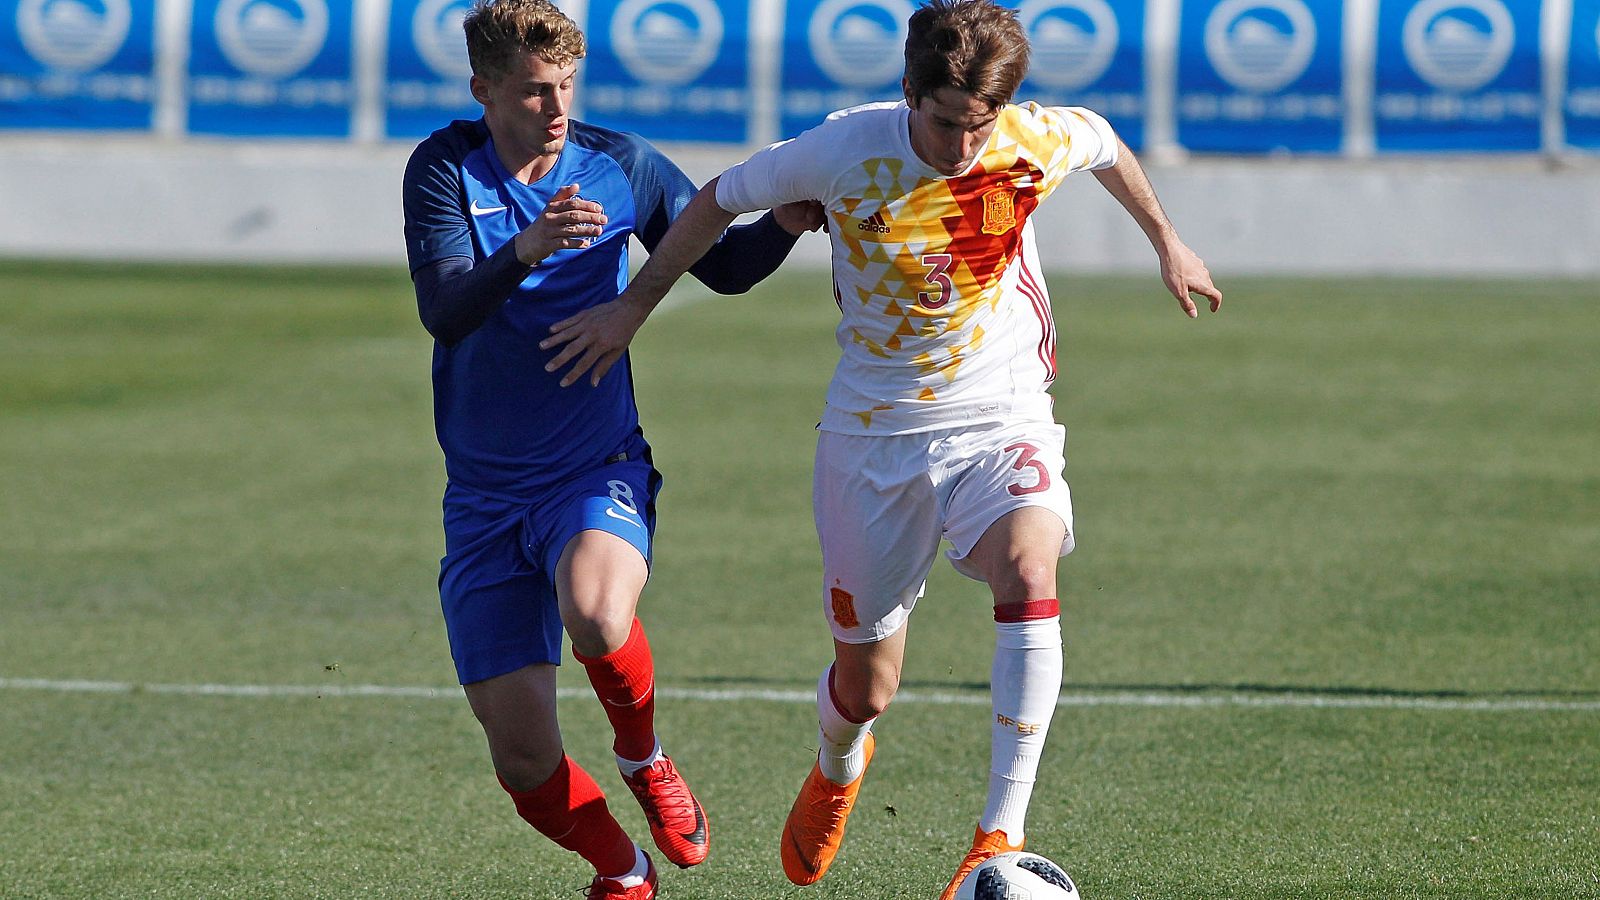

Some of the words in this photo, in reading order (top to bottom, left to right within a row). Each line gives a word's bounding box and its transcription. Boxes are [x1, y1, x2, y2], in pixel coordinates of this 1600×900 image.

[857, 223, 891, 234] adidas
[918, 254, 953, 310] 3
[1003, 442, 1051, 496] 3
[606, 480, 638, 515] 8
